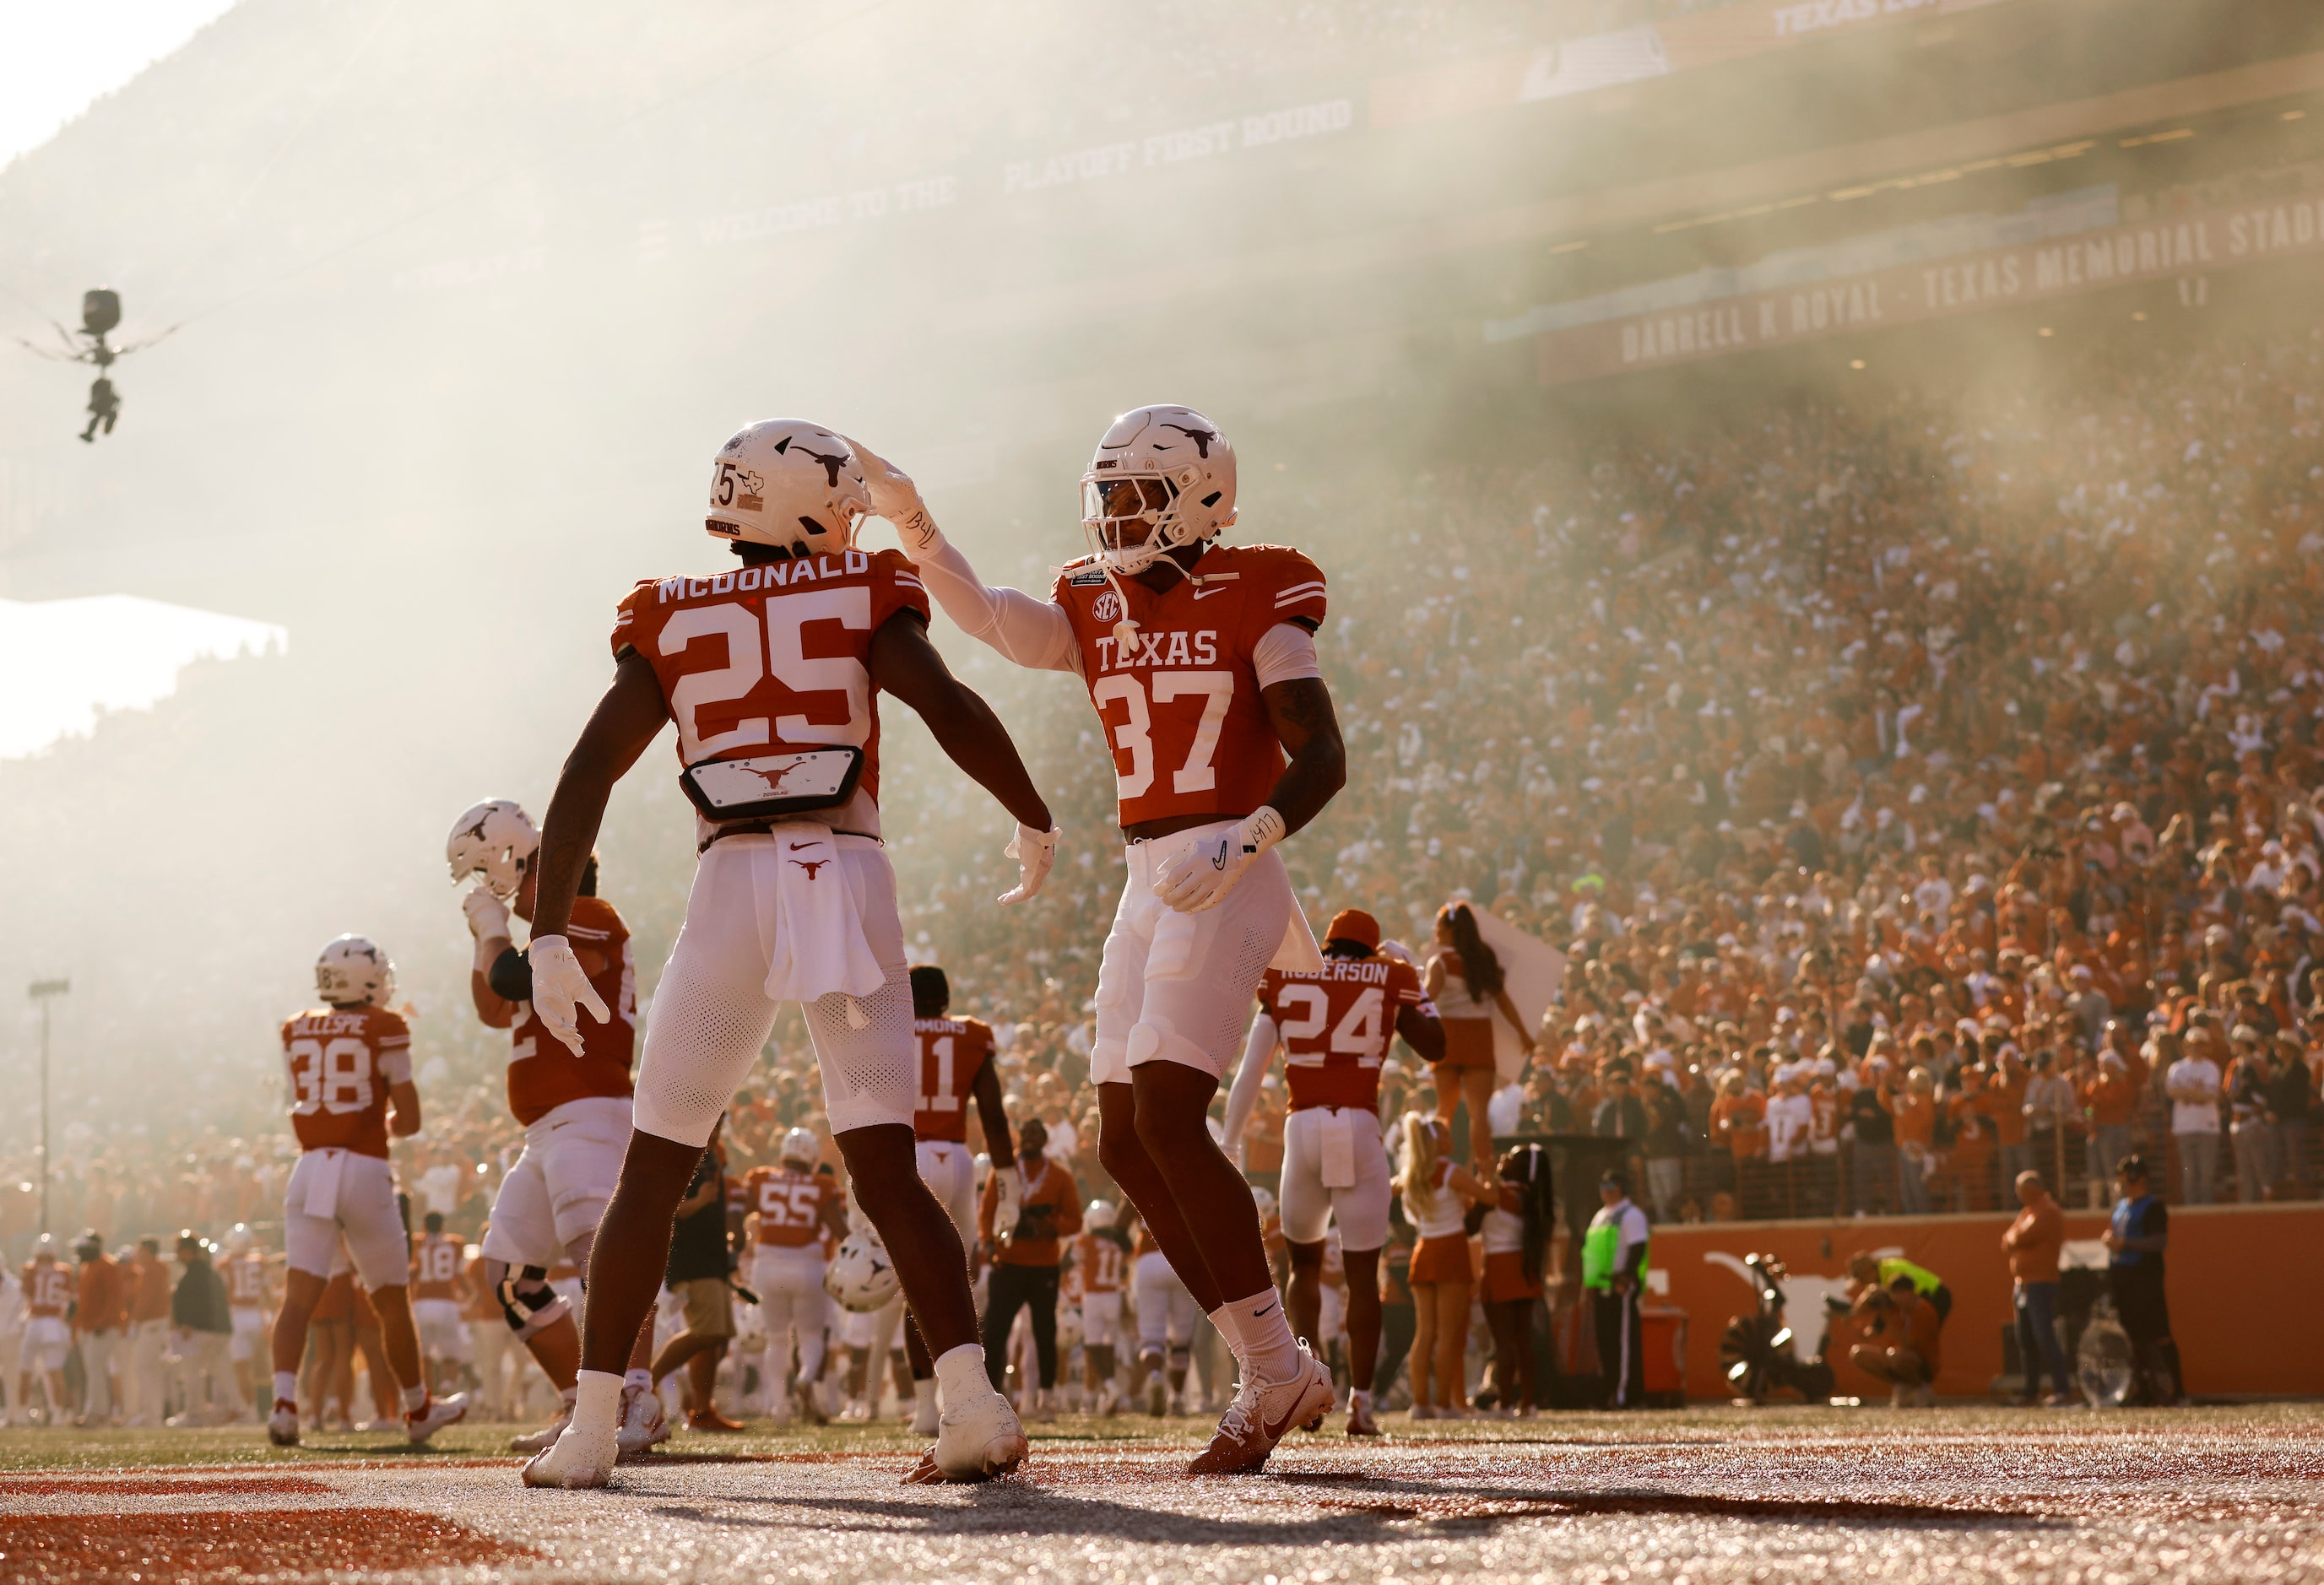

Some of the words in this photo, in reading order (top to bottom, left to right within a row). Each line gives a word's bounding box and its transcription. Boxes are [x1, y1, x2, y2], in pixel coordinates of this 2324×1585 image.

[1003, 147, 1132, 193] PLAYOFF
[1143, 123, 1235, 168] FIRST
[1241, 100, 1352, 148] ROUND
[848, 186, 887, 217] TO
[896, 176, 956, 213] THE
[1621, 306, 1744, 363] DARRELL
[1791, 283, 1883, 334] ROYAL
[1923, 257, 2021, 307] TEXAS
[2035, 221, 2213, 288] MEMORIAL
[1095, 592, 1119, 619] SEC
[658, 587, 871, 761] 25
[1096, 630, 1216, 673] TEXAS
[1093, 671, 1234, 799] 37
[291, 1013, 369, 1036] GILLESPIE
[1277, 983, 1385, 1068] 24
[290, 1037, 373, 1116] 38
[759, 1182, 820, 1228] 55
[420, 1246, 454, 1281] 18
